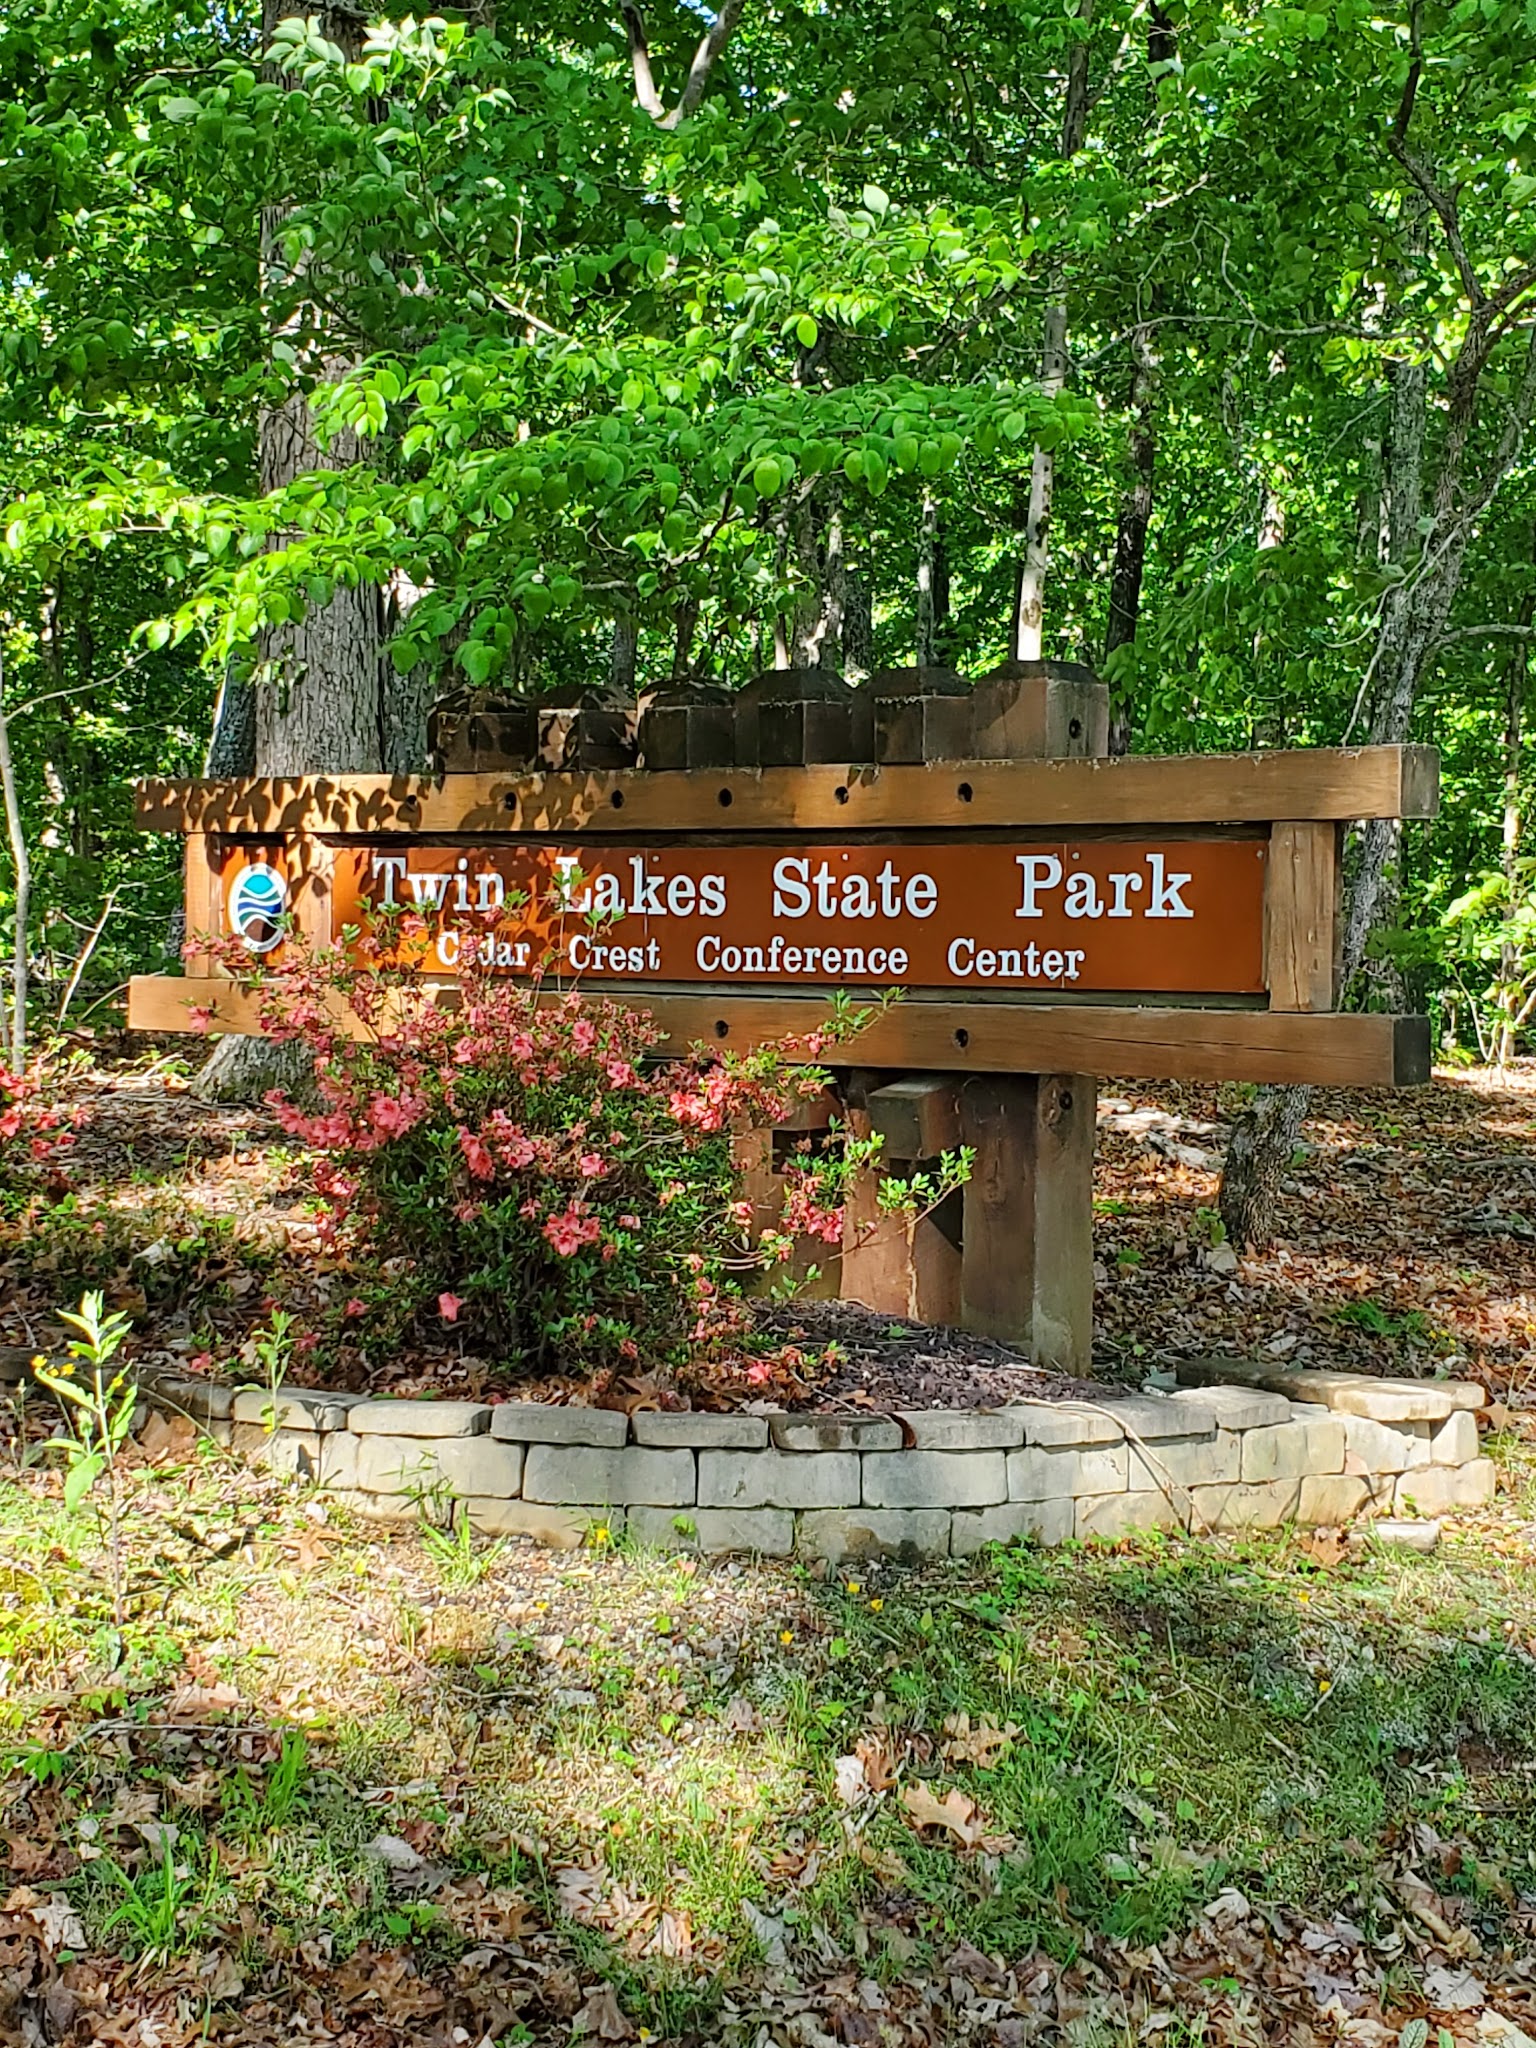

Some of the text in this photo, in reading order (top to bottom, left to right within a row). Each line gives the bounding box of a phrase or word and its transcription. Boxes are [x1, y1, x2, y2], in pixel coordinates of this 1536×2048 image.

[372, 853, 1195, 919] Twin Lakes State Park
[437, 931, 1085, 978] Cdar Crest Conference Center
